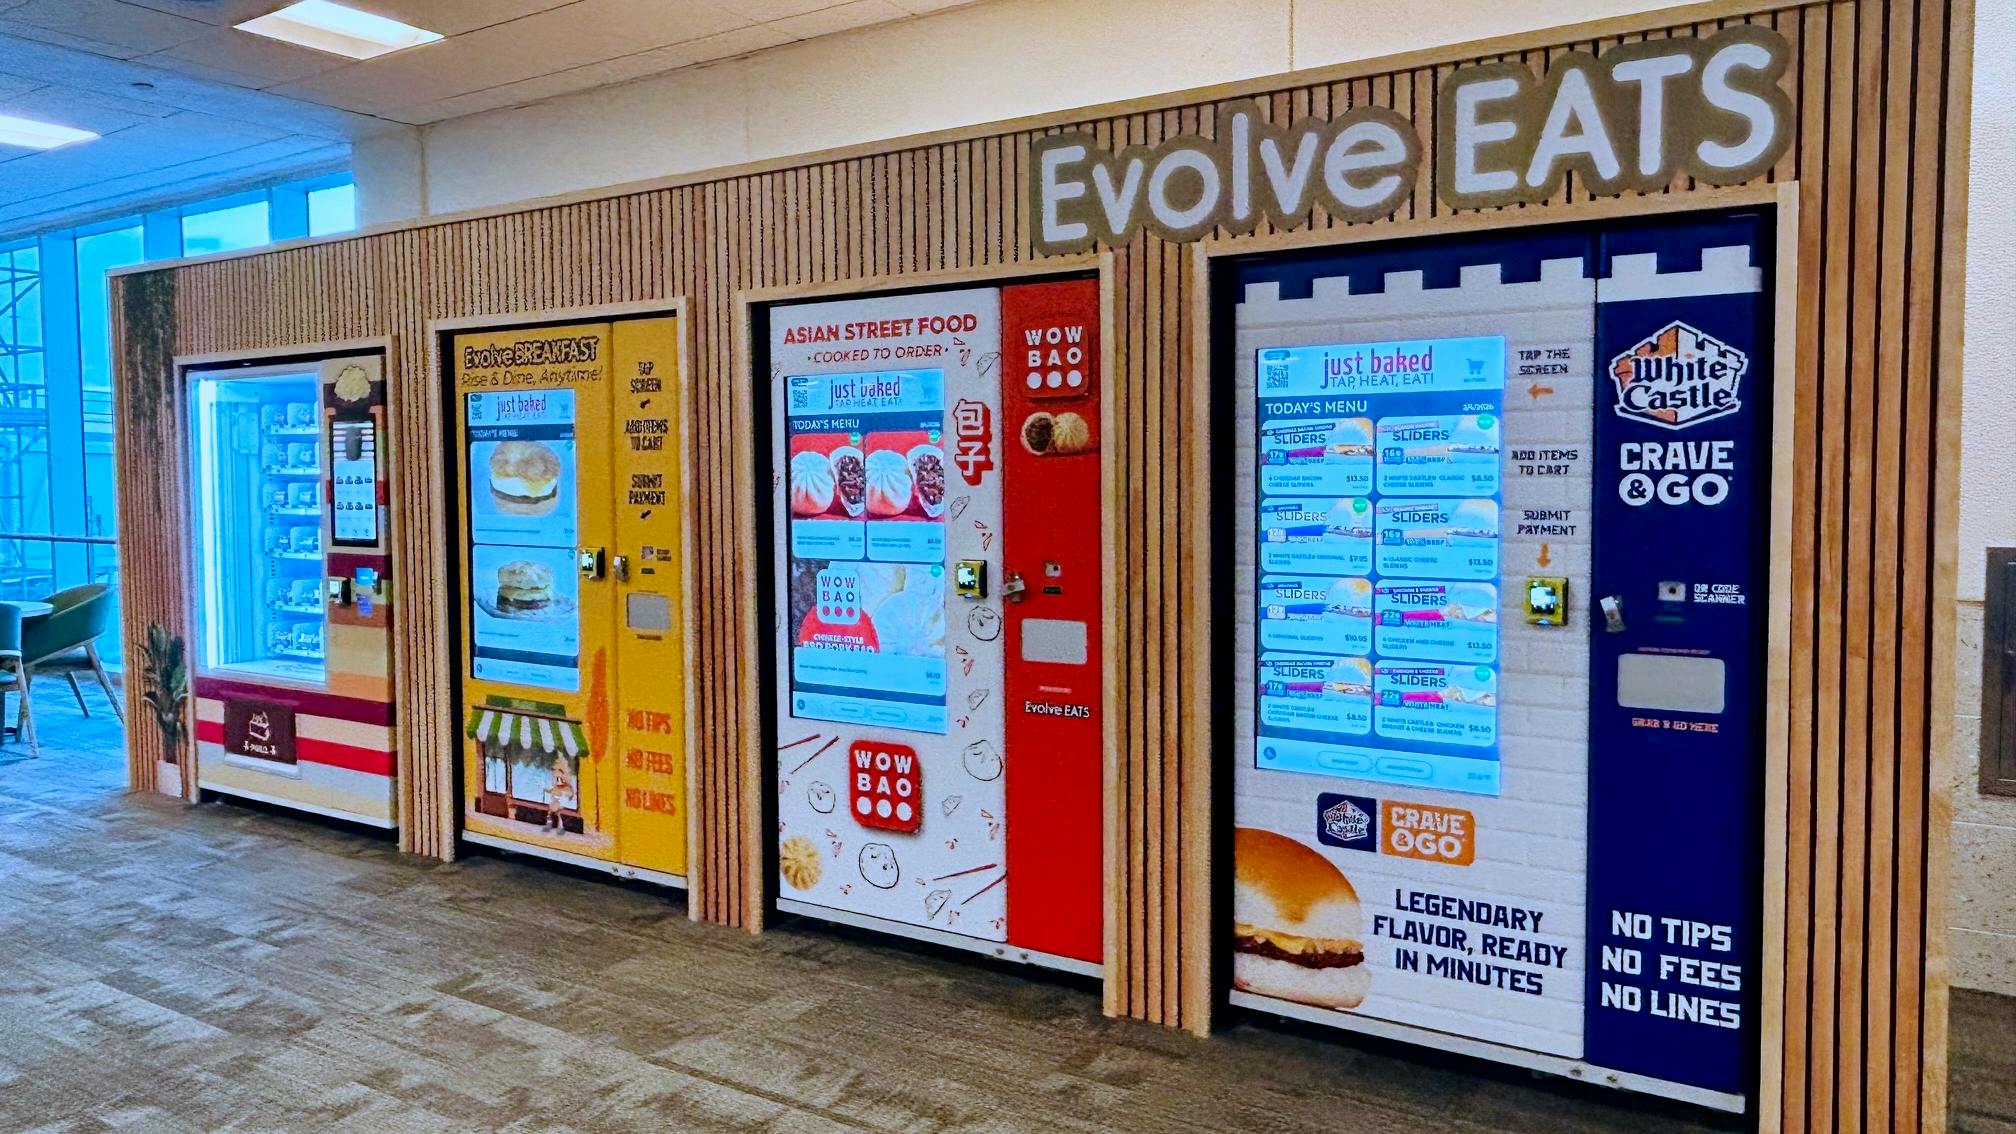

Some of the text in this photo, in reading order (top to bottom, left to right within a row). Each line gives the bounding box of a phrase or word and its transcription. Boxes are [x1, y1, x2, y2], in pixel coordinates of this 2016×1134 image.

[1040, 43, 1775, 243] Evolve EATS
[784, 313, 978, 345] ASIAN STREET FOOD
[1025, 325, 1083, 346] WOW
[464, 336, 600, 369] Evolve BREAKFAST
[813, 344, 943, 364] COOKED TO ORDER
[1027, 346, 1083, 368] BAO
[1519, 348, 1571, 360] TAP THE
[1319, 345, 1433, 389] just baked
[1519, 364, 1569, 376] SCREEN
[1629, 357, 1729, 387] White
[1403, 372, 1435, 385] EAT!
[829, 375, 901, 409] just baked
[1621, 384, 1732, 411] Castle
[496, 393, 547, 421] just baked
[1265, 400, 1368, 415] TODAY'S MENU
[831, 419, 860, 430] MENU
[952, 399, 994, 487] 包子
[1274, 433, 1327, 445] SLIDERS
[1392, 429, 1449, 441] SLIDERS
[1511, 450, 1578, 461] ADD ITEMS
[1620, 440, 1735, 471] CRAVE
[1519, 464, 1571, 476] TO CART
[1276, 511, 1328, 522] SLIDERS
[1392, 512, 1449, 524] SLIDERS
[1523, 510, 1571, 521] SUBMIT
[1517, 524, 1577, 536] PAYMENT
[820, 575, 856, 589] WOW
[1693, 584, 1740, 594] QR CODE
[822, 591, 856, 604] BAO
[1276, 589, 1327, 600] SLIDERS
[1391, 594, 1448, 606] SLIDERS
[1693, 593, 1746, 605] SCANNER
[1273, 667, 1325, 680] SLIDERS
[1390, 674, 1447, 688] SLIDERS
[1025, 700, 1090, 719] Evolve EATS
[854, 749, 912, 774] WOW
[857, 772, 912, 797] BAO
[1332, 812, 1363, 825] White
[1391, 806, 1465, 836] CRAVE
[1395, 888, 1544, 934] LEGENDARY
[1611, 909, 1732, 952] NO TIPS
[1373, 915, 1568, 969] FLAVOR, READY
[1395, 948, 1543, 996] IN MINUTES
[1602, 945, 1742, 992] NO FEES
[1601, 981, 1741, 1030] NO LINES
